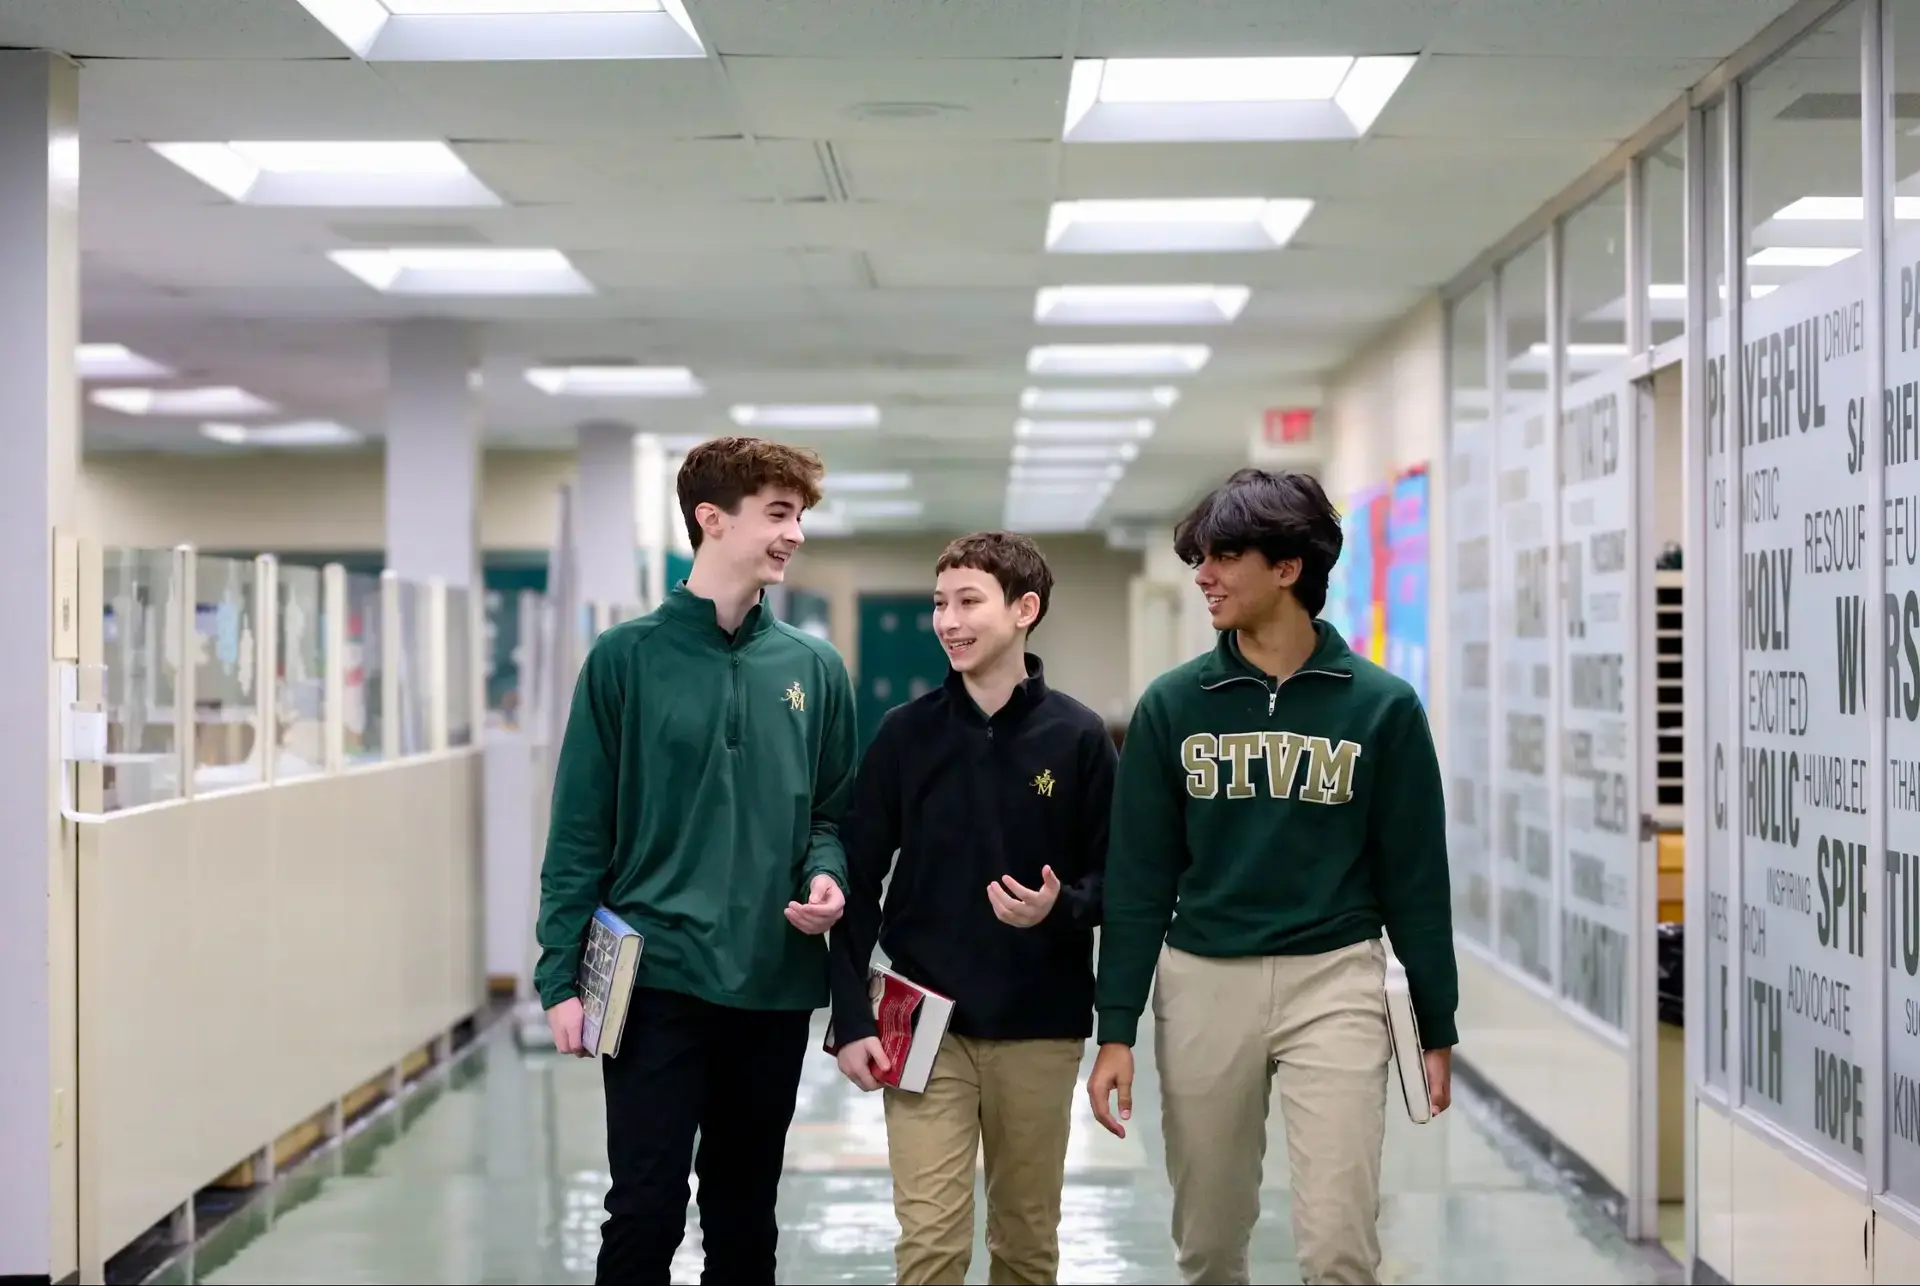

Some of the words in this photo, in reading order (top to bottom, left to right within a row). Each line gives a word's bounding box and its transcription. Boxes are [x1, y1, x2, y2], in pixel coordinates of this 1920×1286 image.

[1825, 298, 1864, 363] DRIVE
[1744, 548, 1793, 652] HOLY
[1750, 670, 1808, 737] EXCITED
[1181, 731, 1361, 805] STVM
[1767, 867, 1812, 915] INSPIRING
[1787, 963, 1851, 1036] ADVOCATE
[1814, 1046, 1864, 1155] HOPE
